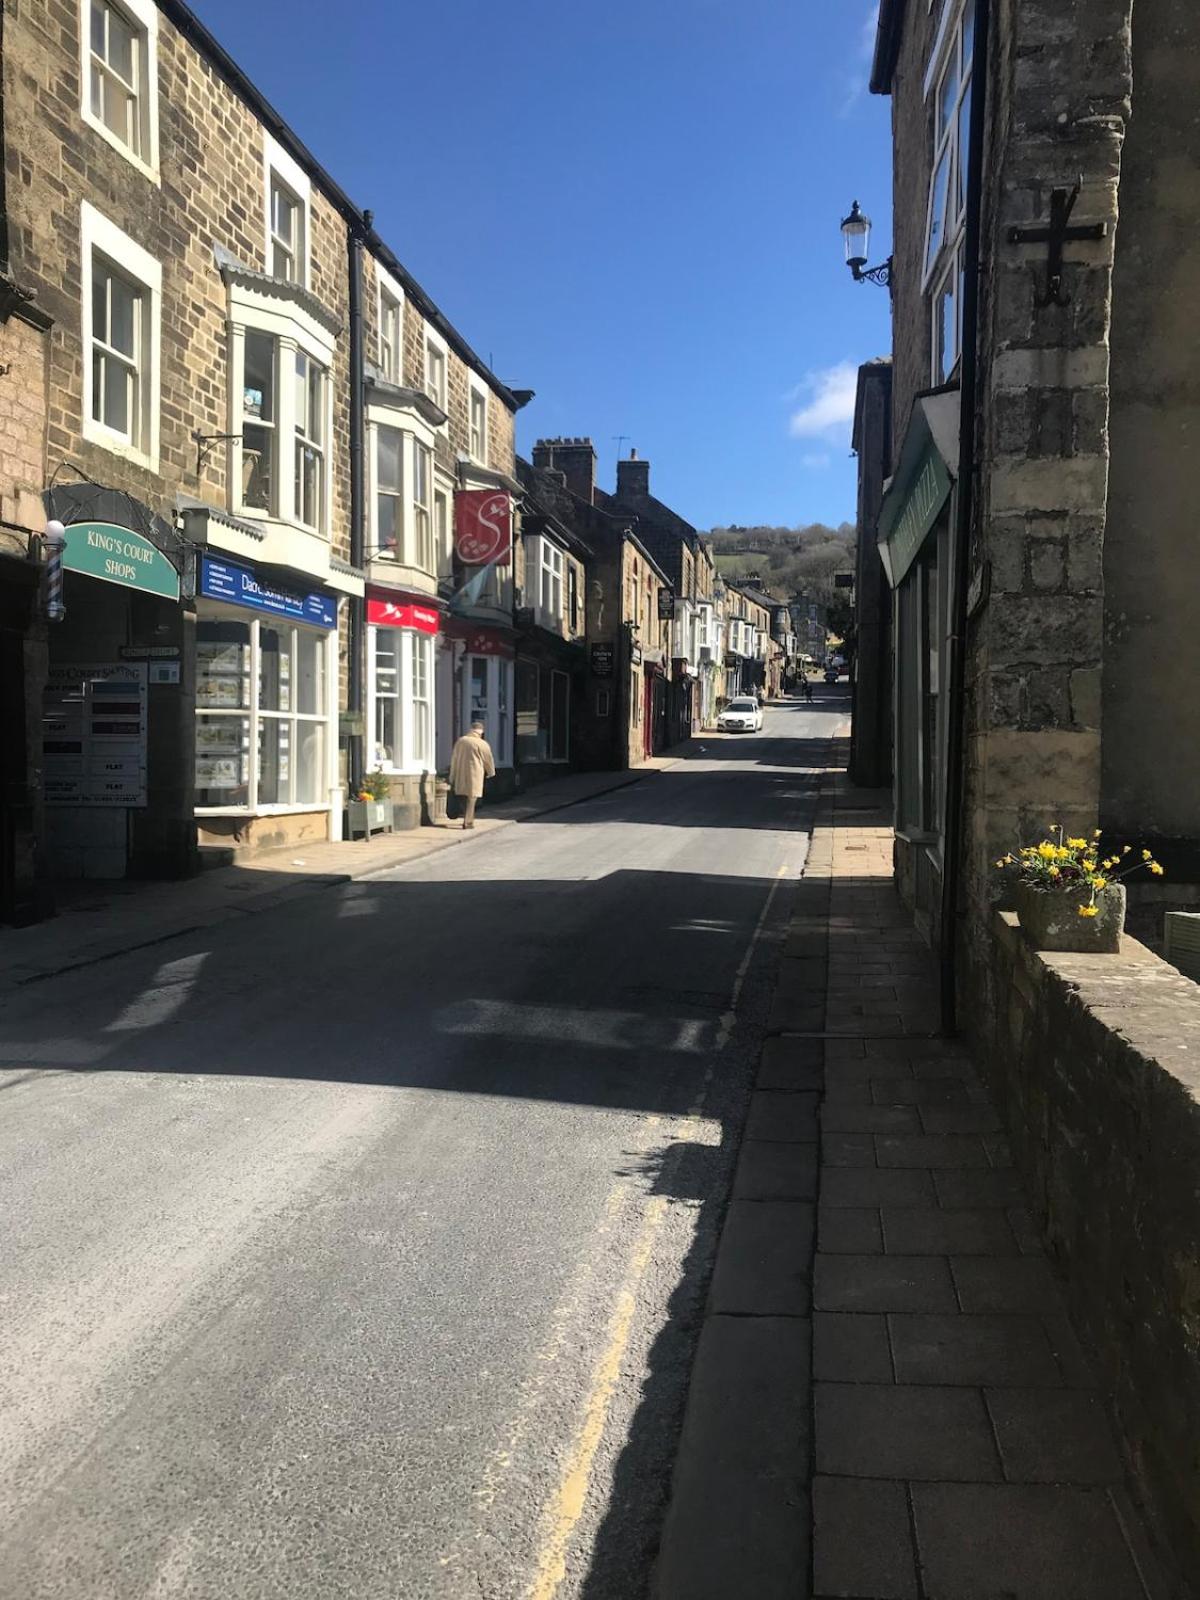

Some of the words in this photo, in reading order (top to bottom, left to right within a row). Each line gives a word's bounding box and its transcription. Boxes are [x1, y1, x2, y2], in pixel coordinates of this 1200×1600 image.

[88, 531, 122, 554] KING'S
[123, 543, 154, 569] COURT
[105, 559, 137, 581] SHOPS
